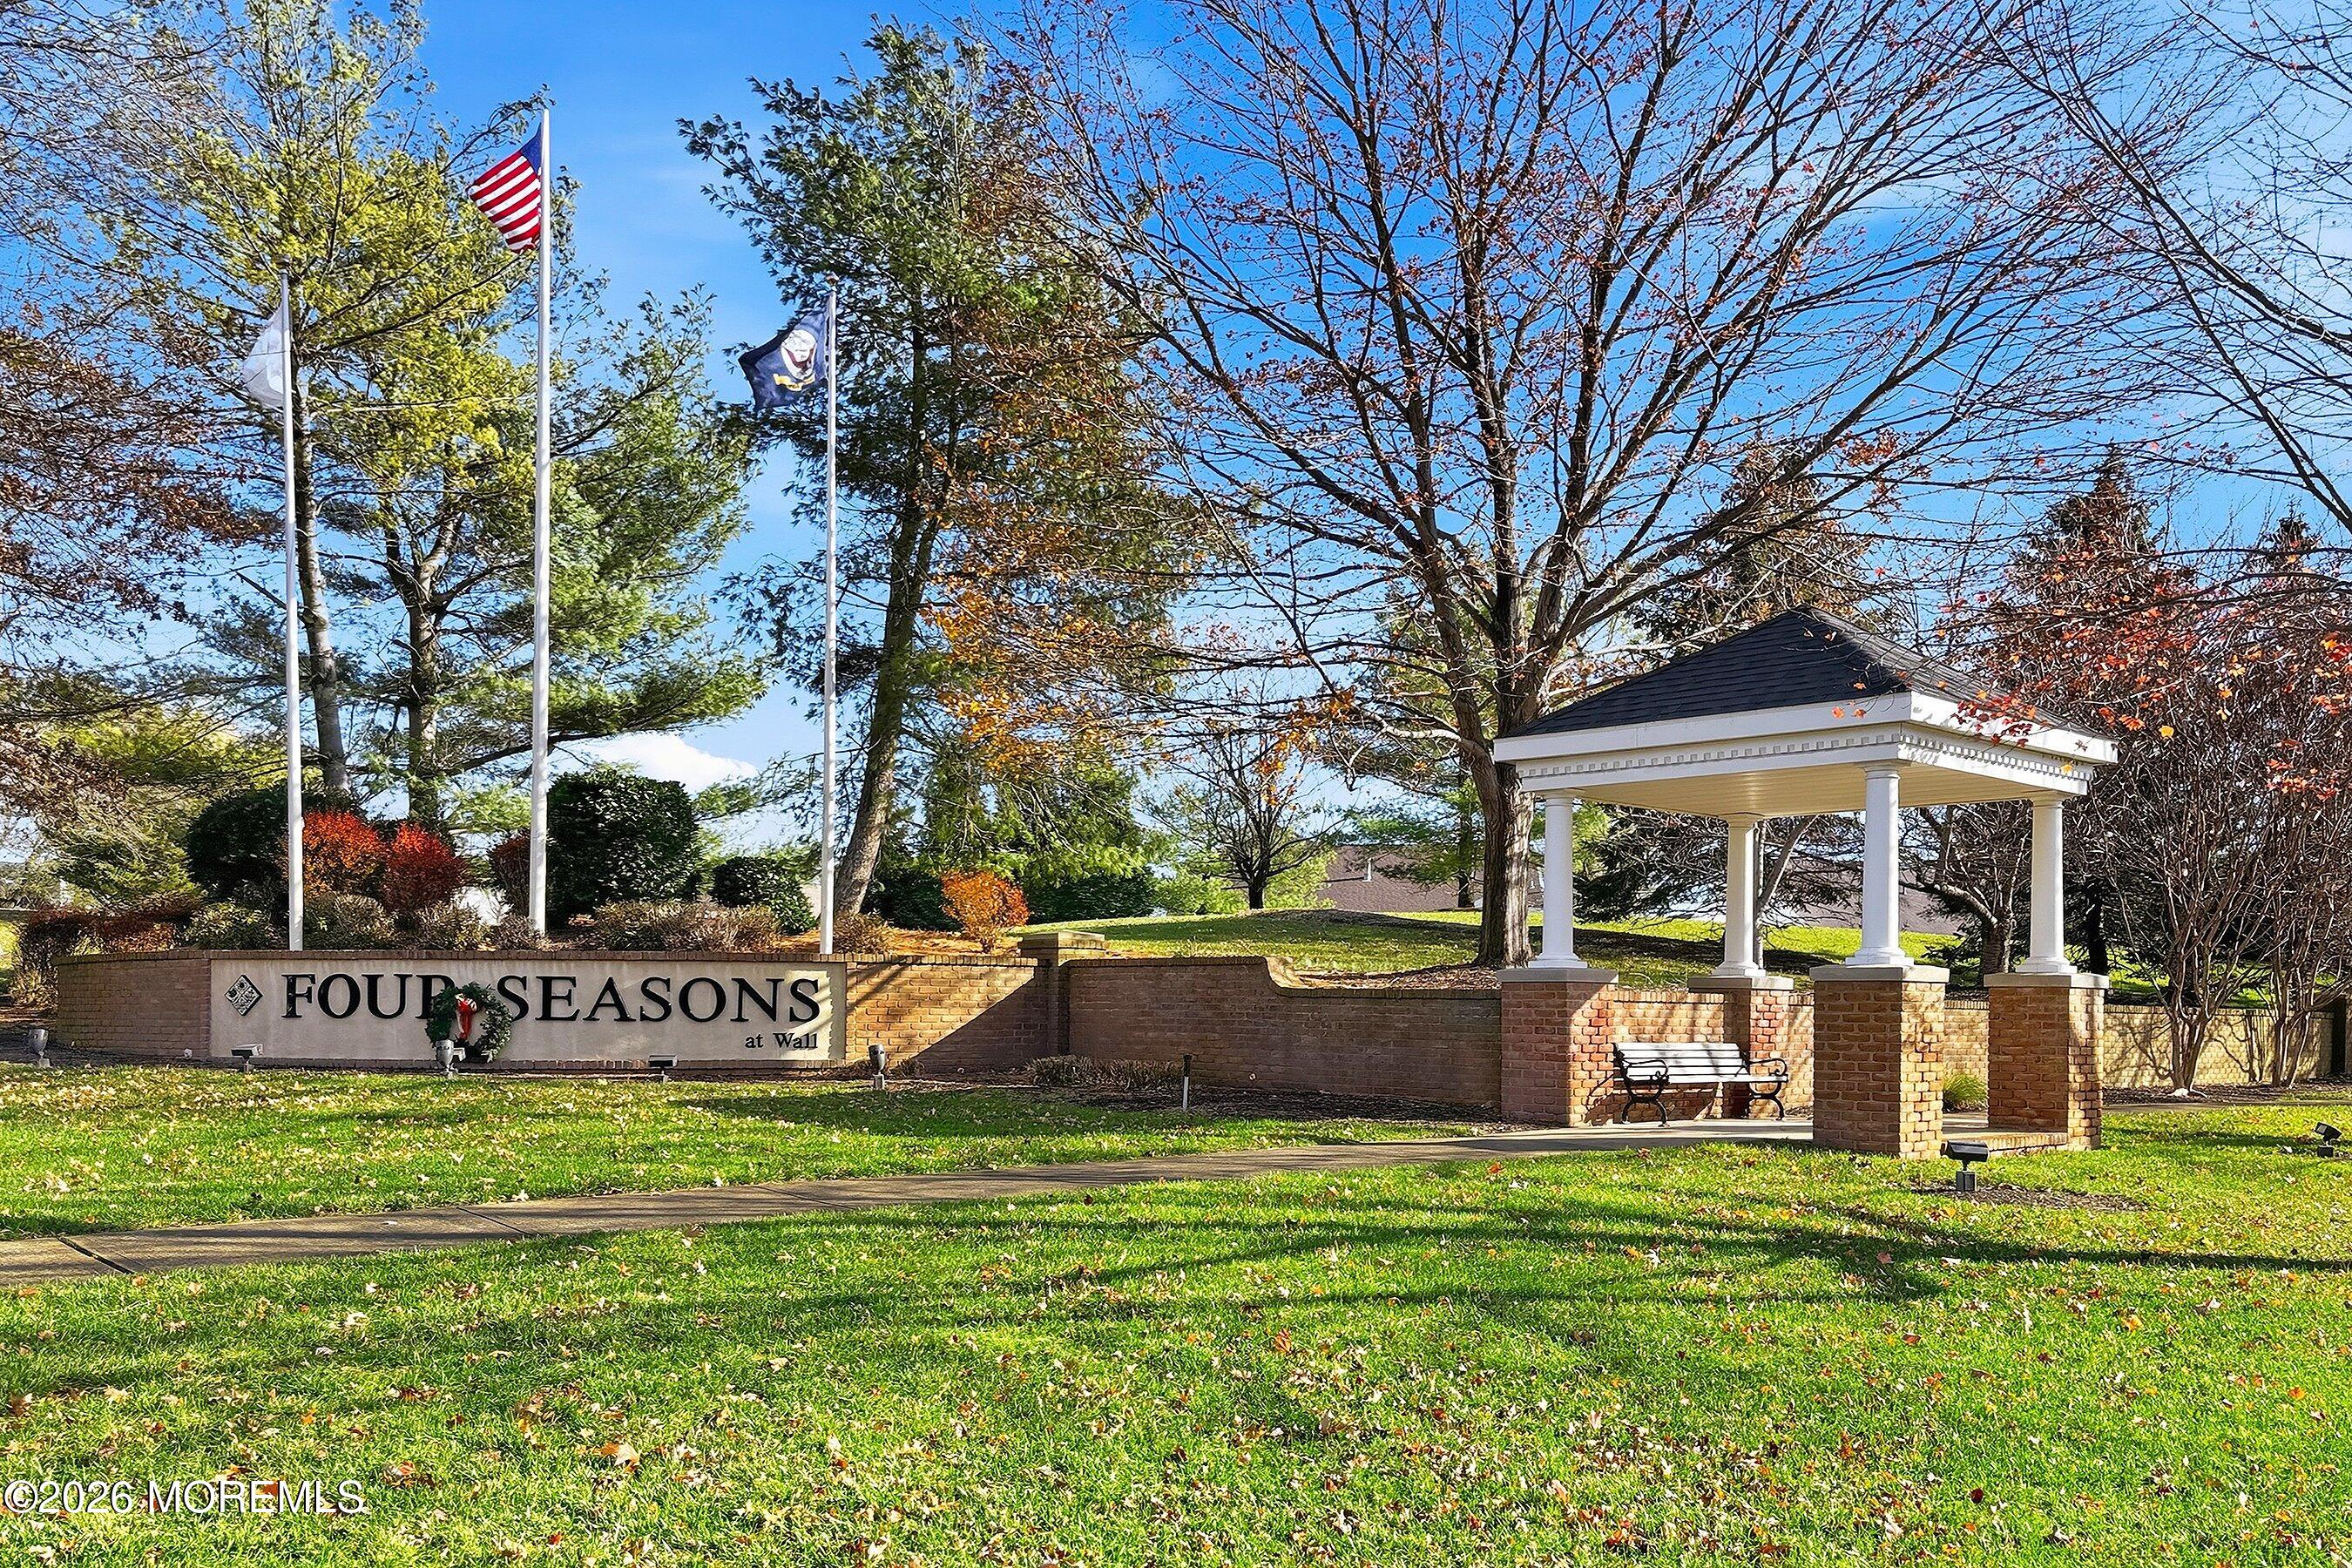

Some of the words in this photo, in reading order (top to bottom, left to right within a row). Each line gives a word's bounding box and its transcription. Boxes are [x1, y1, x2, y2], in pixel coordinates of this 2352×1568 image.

[497, 975, 821, 1023] SEASONS
[745, 1033, 764, 1049] at
[772, 1032, 819, 1049] Wall
